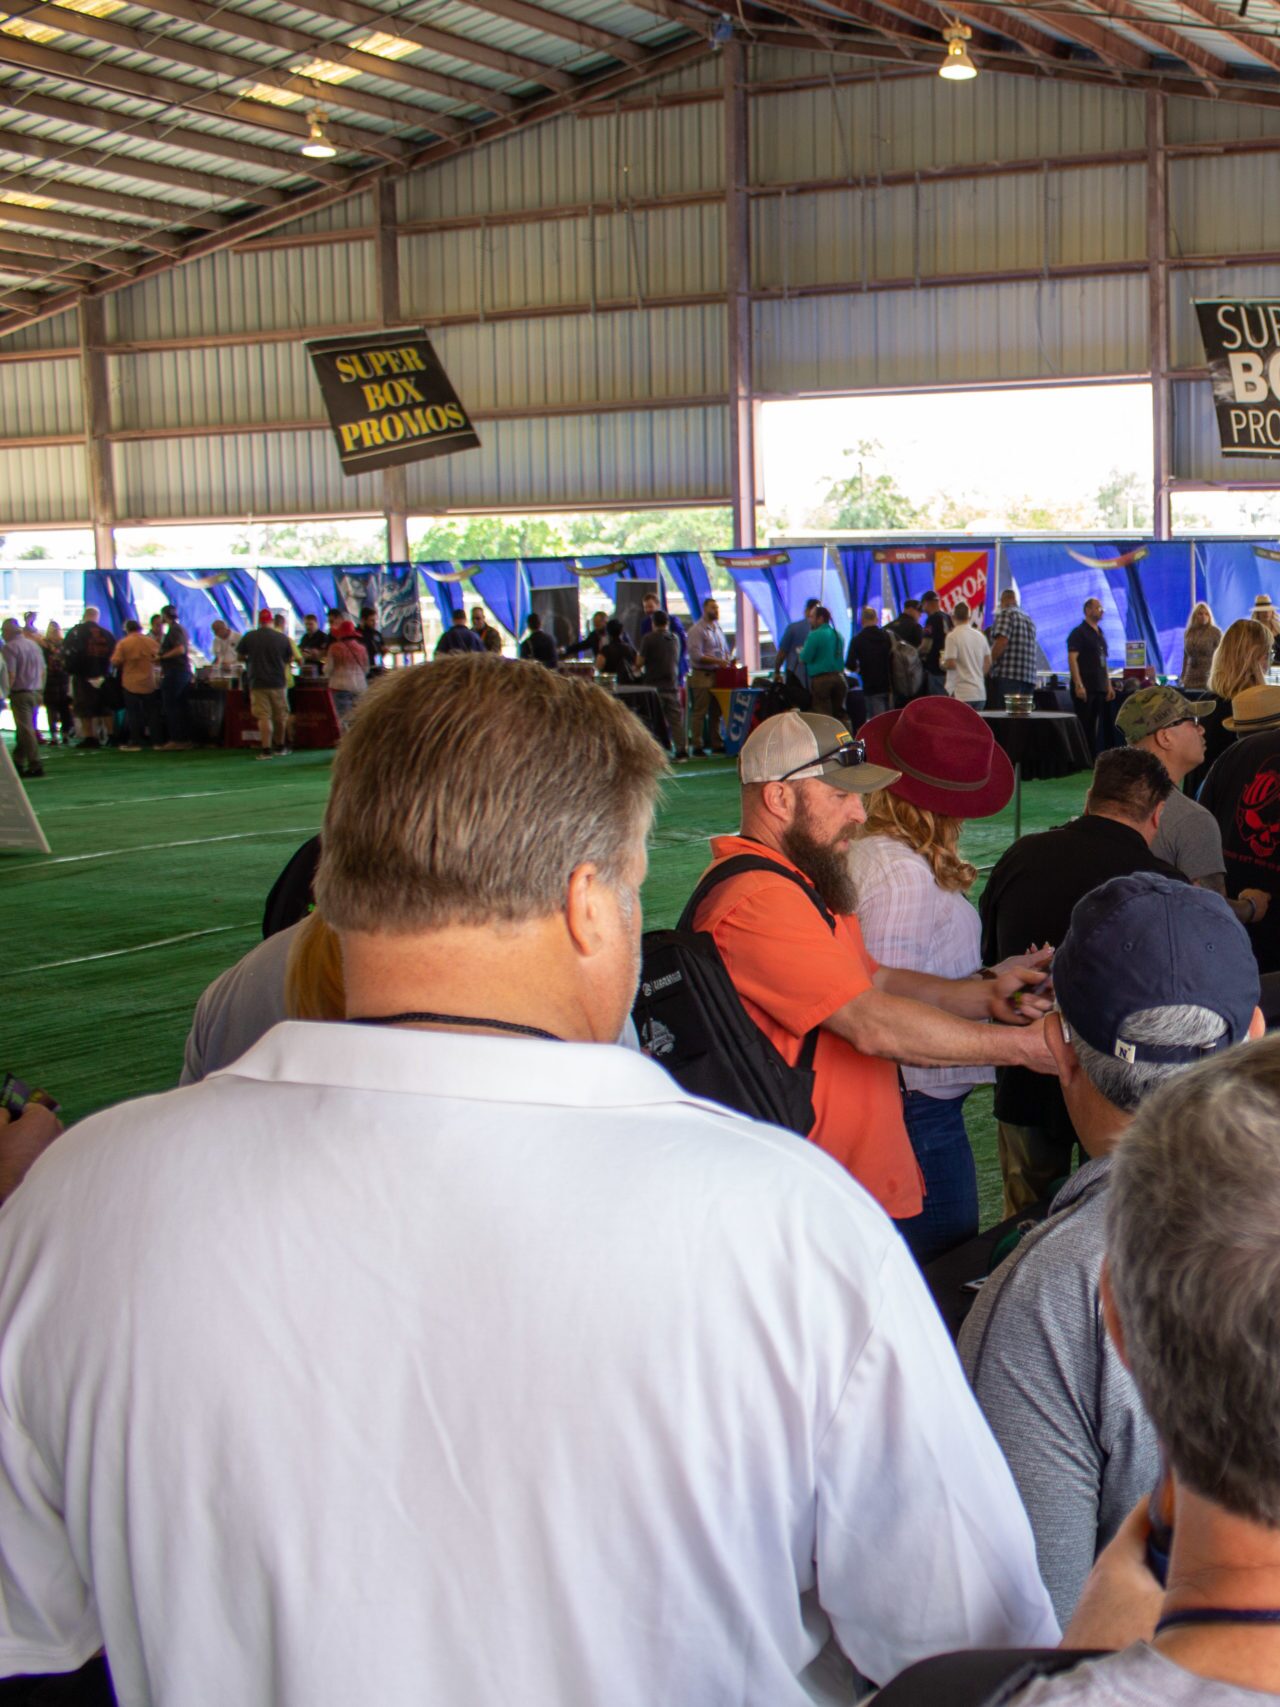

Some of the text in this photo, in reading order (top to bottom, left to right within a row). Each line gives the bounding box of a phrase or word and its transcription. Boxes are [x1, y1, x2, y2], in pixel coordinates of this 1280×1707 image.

[335, 347, 426, 384] SUPER
[361, 378, 425, 412] BOX
[339, 402, 465, 452] PROMOS
[1153, 707, 1174, 722] ARMY
